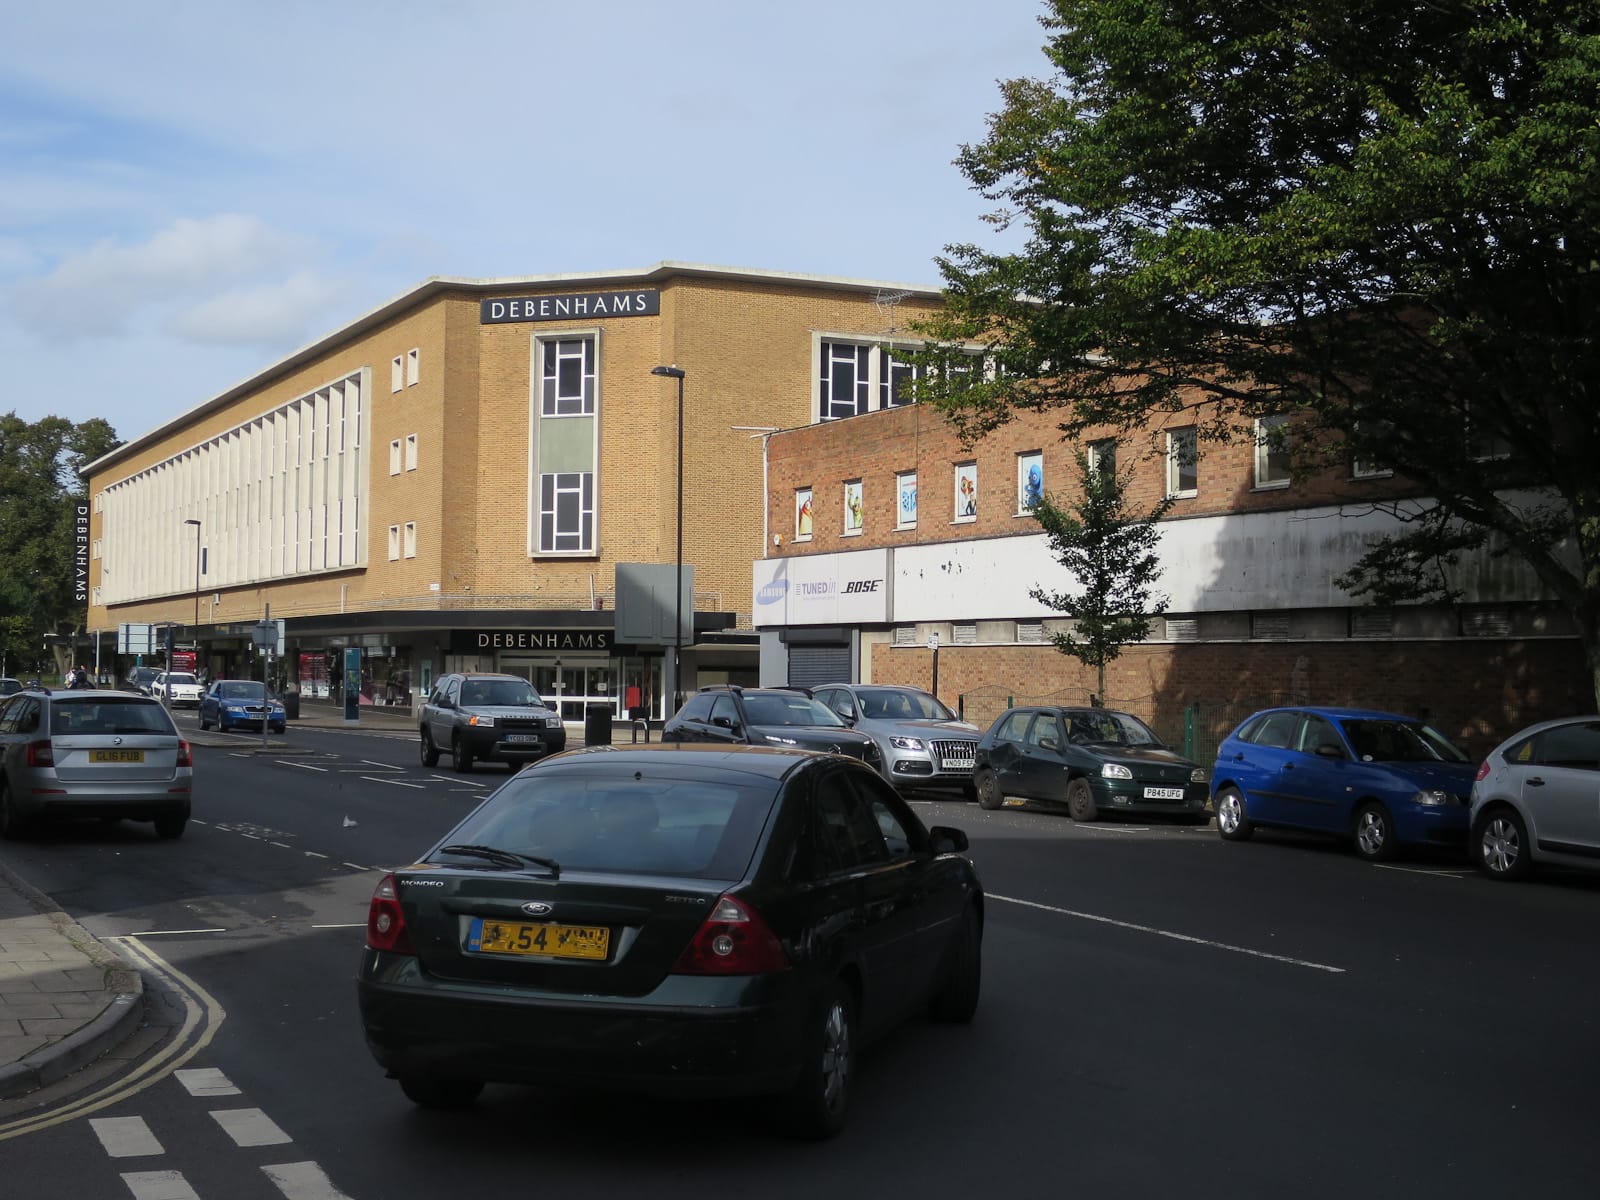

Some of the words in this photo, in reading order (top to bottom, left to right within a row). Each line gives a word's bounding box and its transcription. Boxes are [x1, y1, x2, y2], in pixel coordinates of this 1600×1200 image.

[491, 294, 647, 319] DEBENHAMS
[76, 506, 88, 601] DEBENHAMS
[841, 579, 884, 594] BOSE
[478, 633, 607, 648] DEBENHAMS
[120, 751, 140, 761] FUB
[1147, 788, 1166, 797] P845
[1166, 789, 1181, 798] UFG
[400, 880, 444, 888] MONDEO
